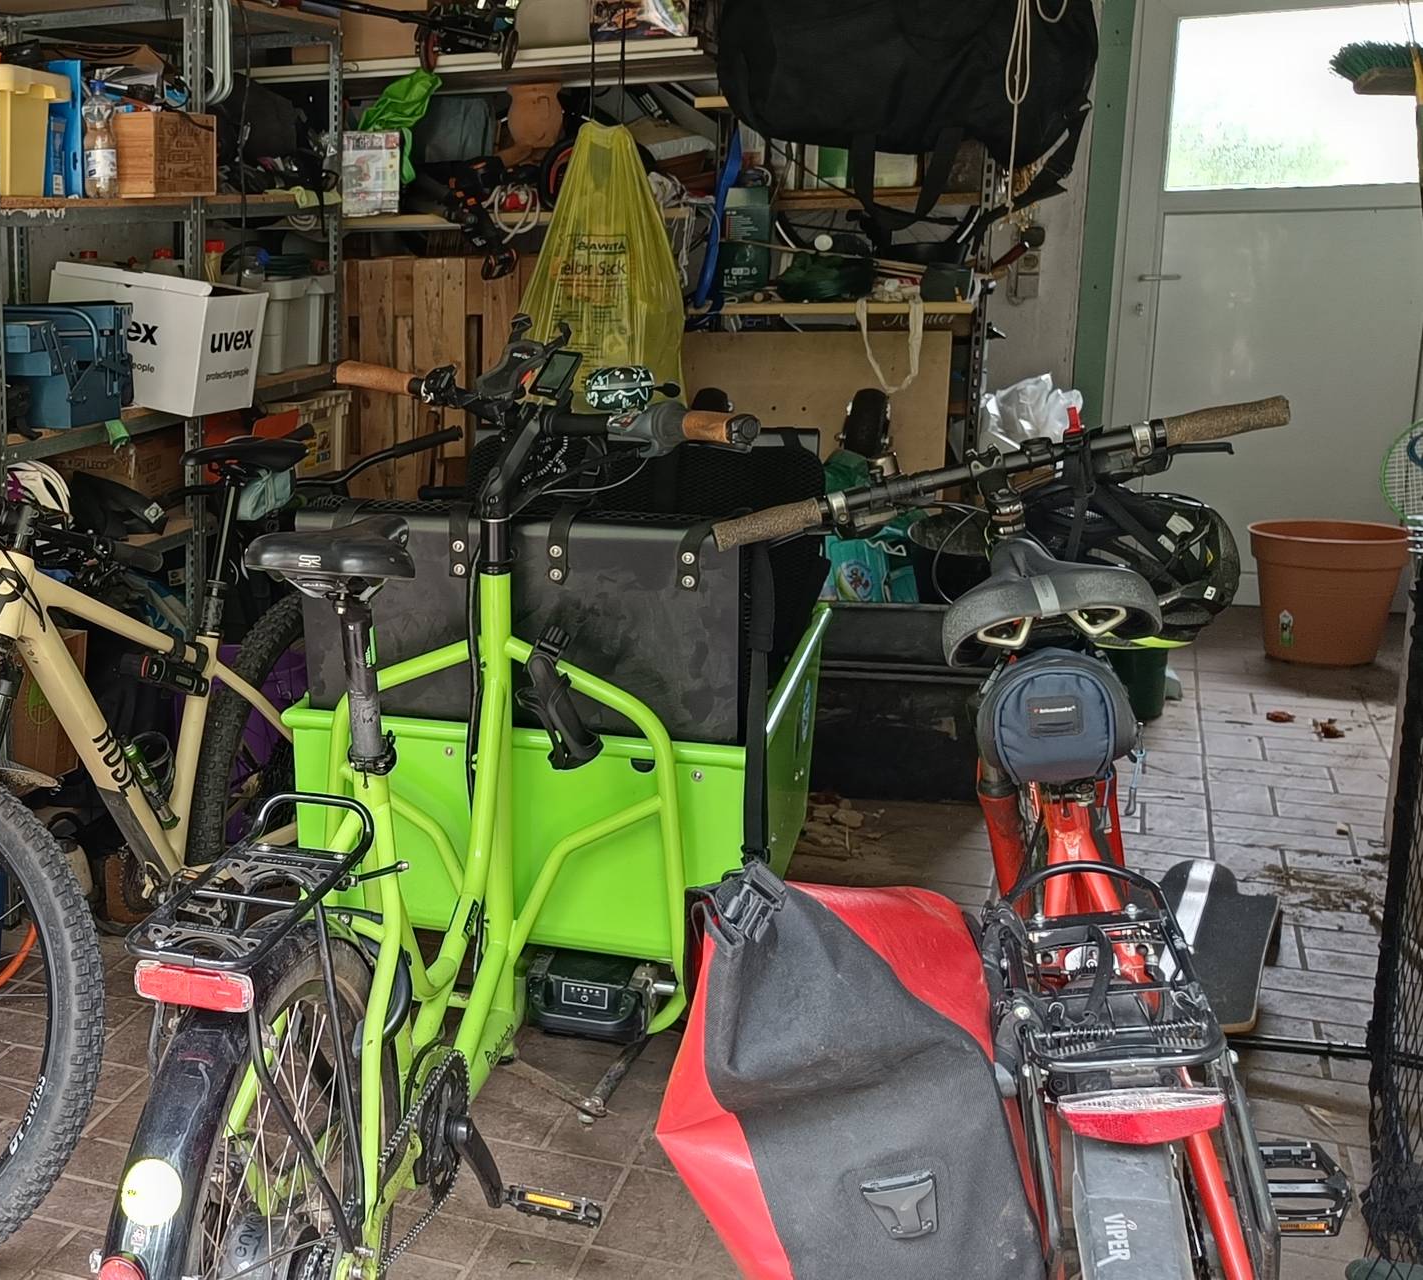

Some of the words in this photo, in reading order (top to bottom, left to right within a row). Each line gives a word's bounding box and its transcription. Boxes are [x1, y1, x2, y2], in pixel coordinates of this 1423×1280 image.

[127, 321, 158, 346] ex
[209, 329, 254, 354] uvex
[130, 363, 155, 374] eople
[9, 1123, 24, 1155] DT
[24, 1075, 46, 1126] SWISS
[1097, 1212, 1132, 1268] VIPER
